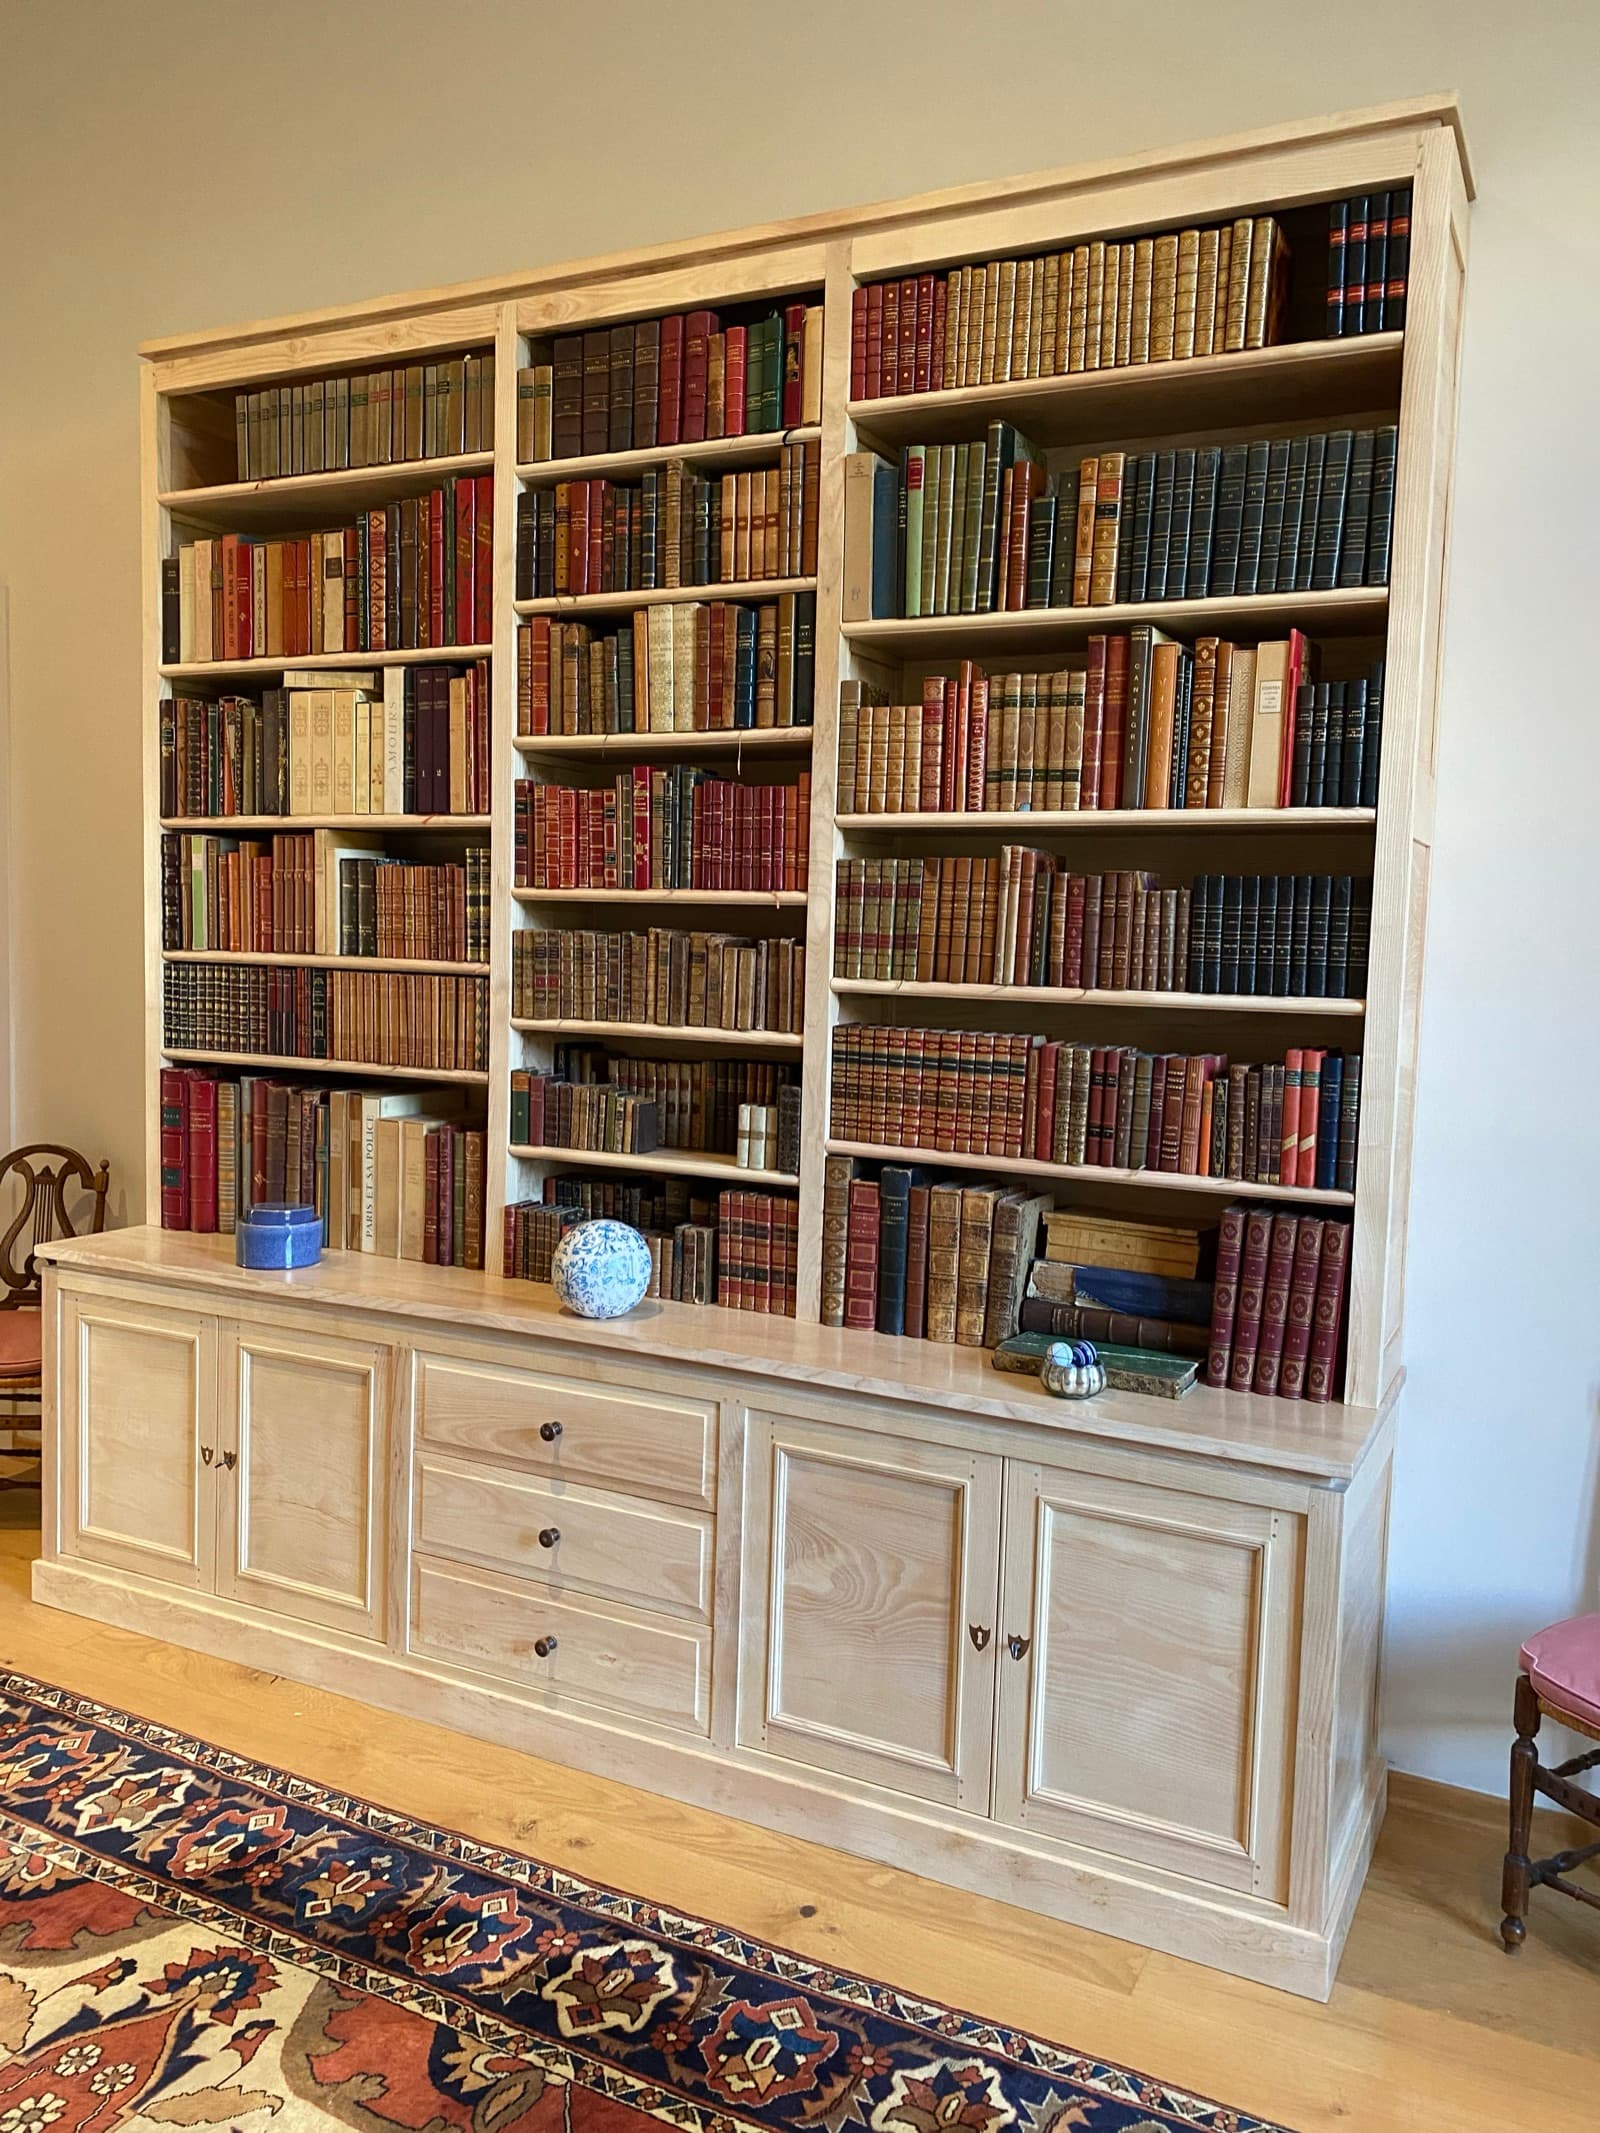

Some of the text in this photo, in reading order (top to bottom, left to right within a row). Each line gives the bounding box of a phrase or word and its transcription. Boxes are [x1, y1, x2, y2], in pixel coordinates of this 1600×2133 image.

[388, 701, 398, 776] AMOURS
[1129, 662, 1141, 765] CANTEGRIL
[365, 1115, 375, 1238] PARIS ET SA POLICE
